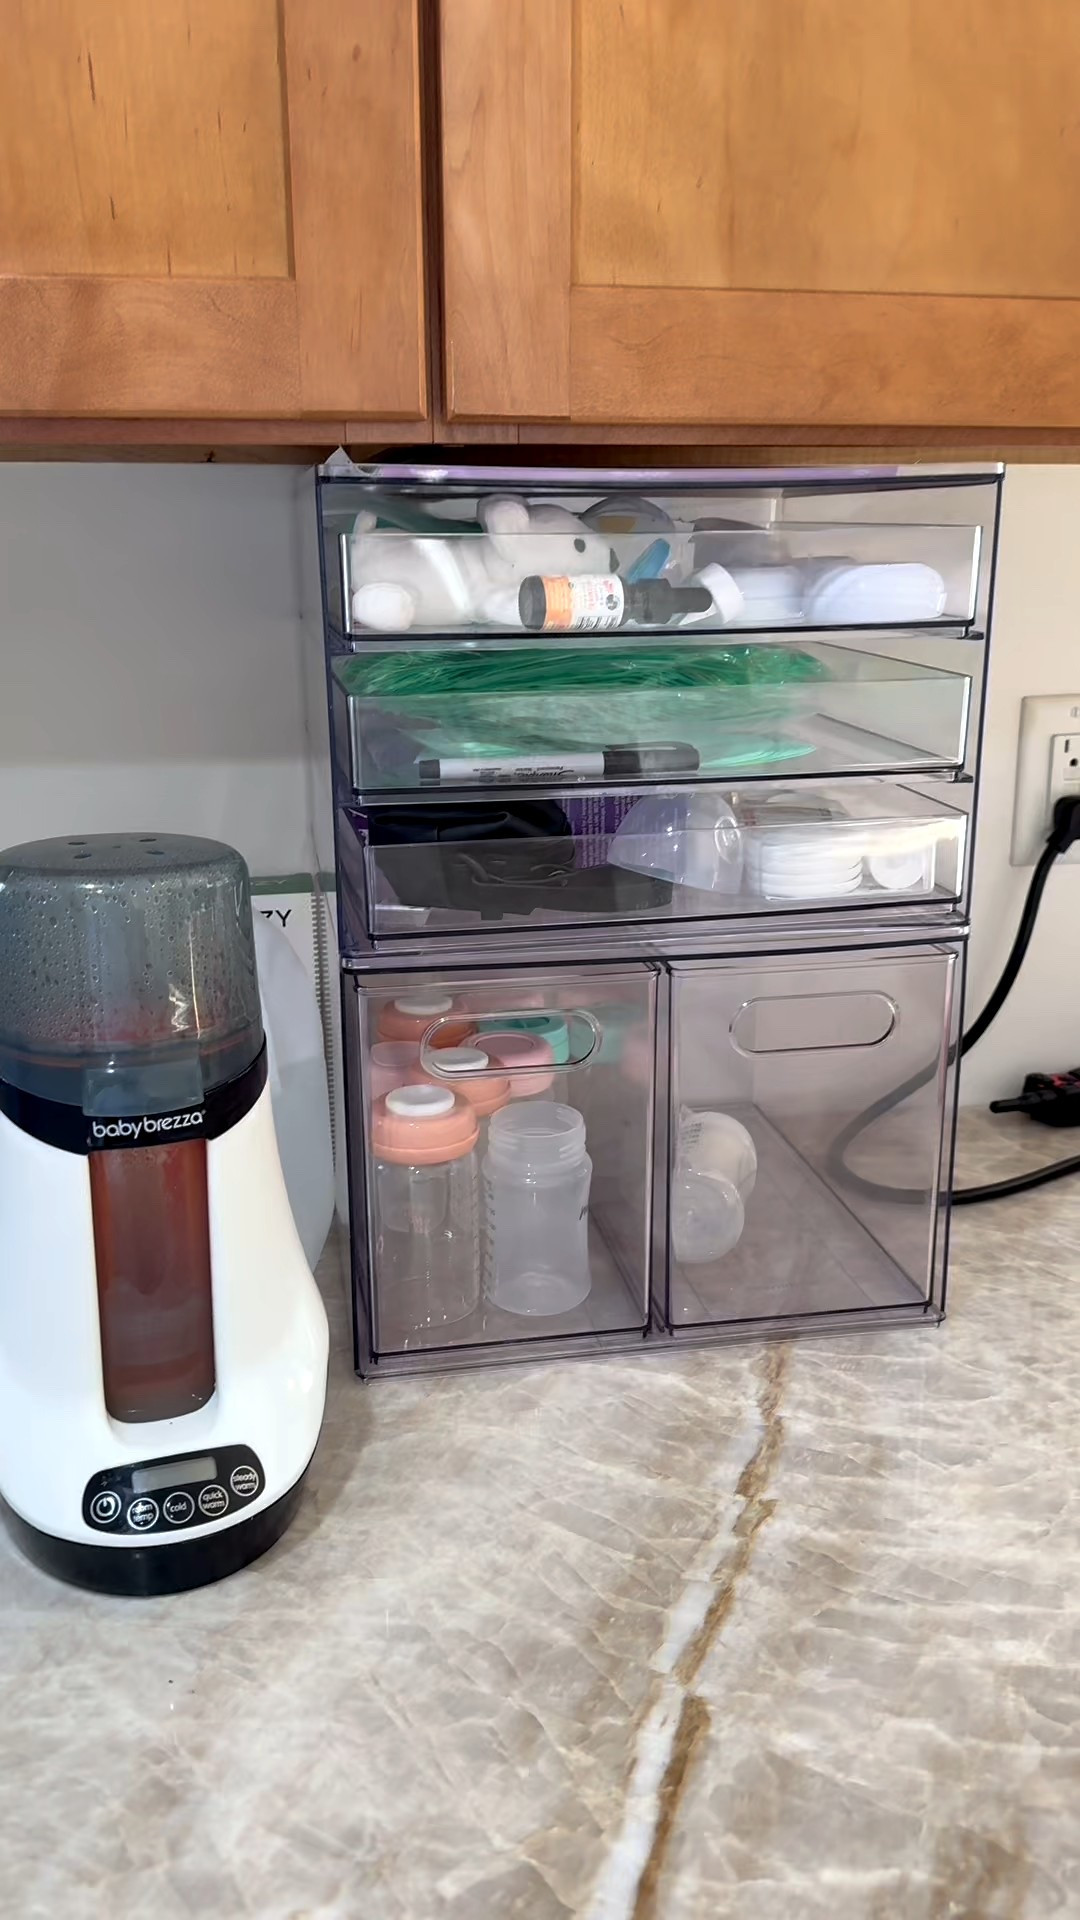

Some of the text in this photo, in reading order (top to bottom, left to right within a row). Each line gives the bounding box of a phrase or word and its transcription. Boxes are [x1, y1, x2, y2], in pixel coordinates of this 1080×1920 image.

[234, 1482, 256, 1491] warm
[202, 1490, 223, 1502] quick
[169, 1502, 187, 1513] cold
[202, 1500, 225, 1510] warm
